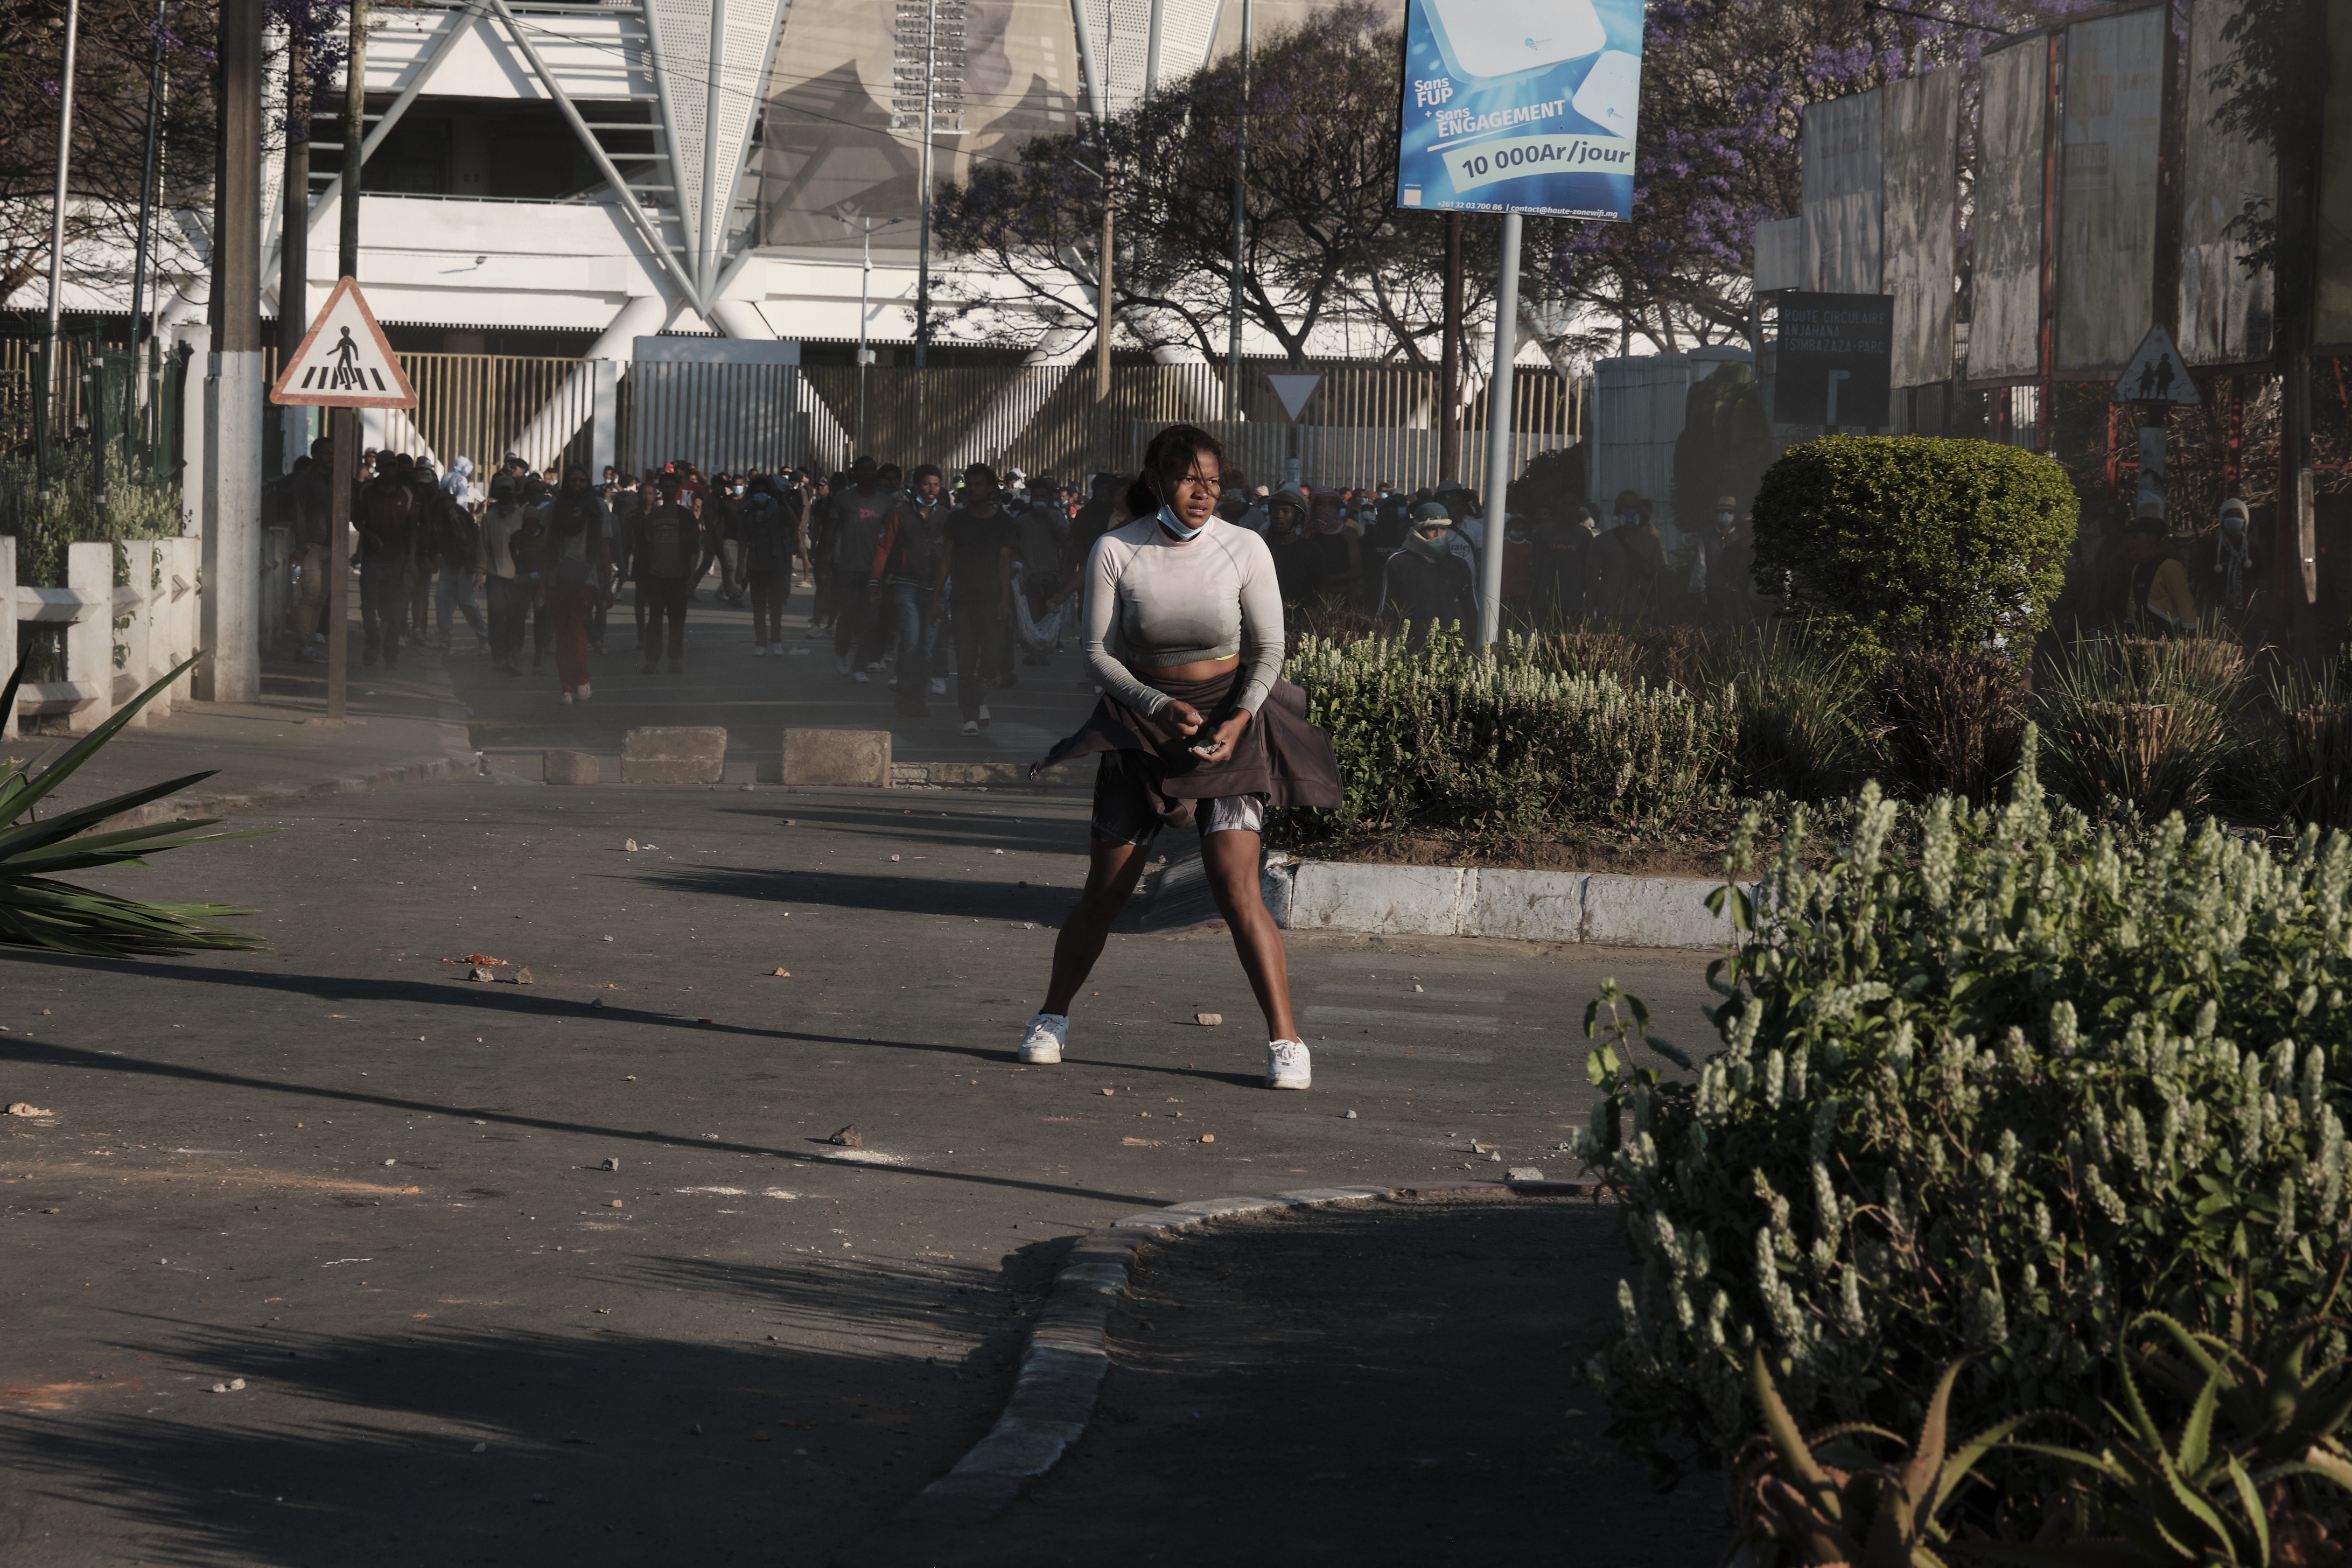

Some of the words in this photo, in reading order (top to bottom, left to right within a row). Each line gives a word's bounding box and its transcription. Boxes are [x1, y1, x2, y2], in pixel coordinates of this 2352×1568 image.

[1414, 78, 1450, 92] Sans
[1417, 87, 1453, 108] FUP
[1435, 107, 1471, 122] Sans
[1438, 99, 1566, 138] ENGAGEMENT
[1461, 156, 1488, 178] 10
[1495, 141, 1631, 169] 000Ar/jour
[1510, 205, 1618, 218] contact@haute-zonewifi.mg
[1784, 309, 1818, 322] ROUTE
[1824, 311, 1885, 324] CIRCULAIRE
